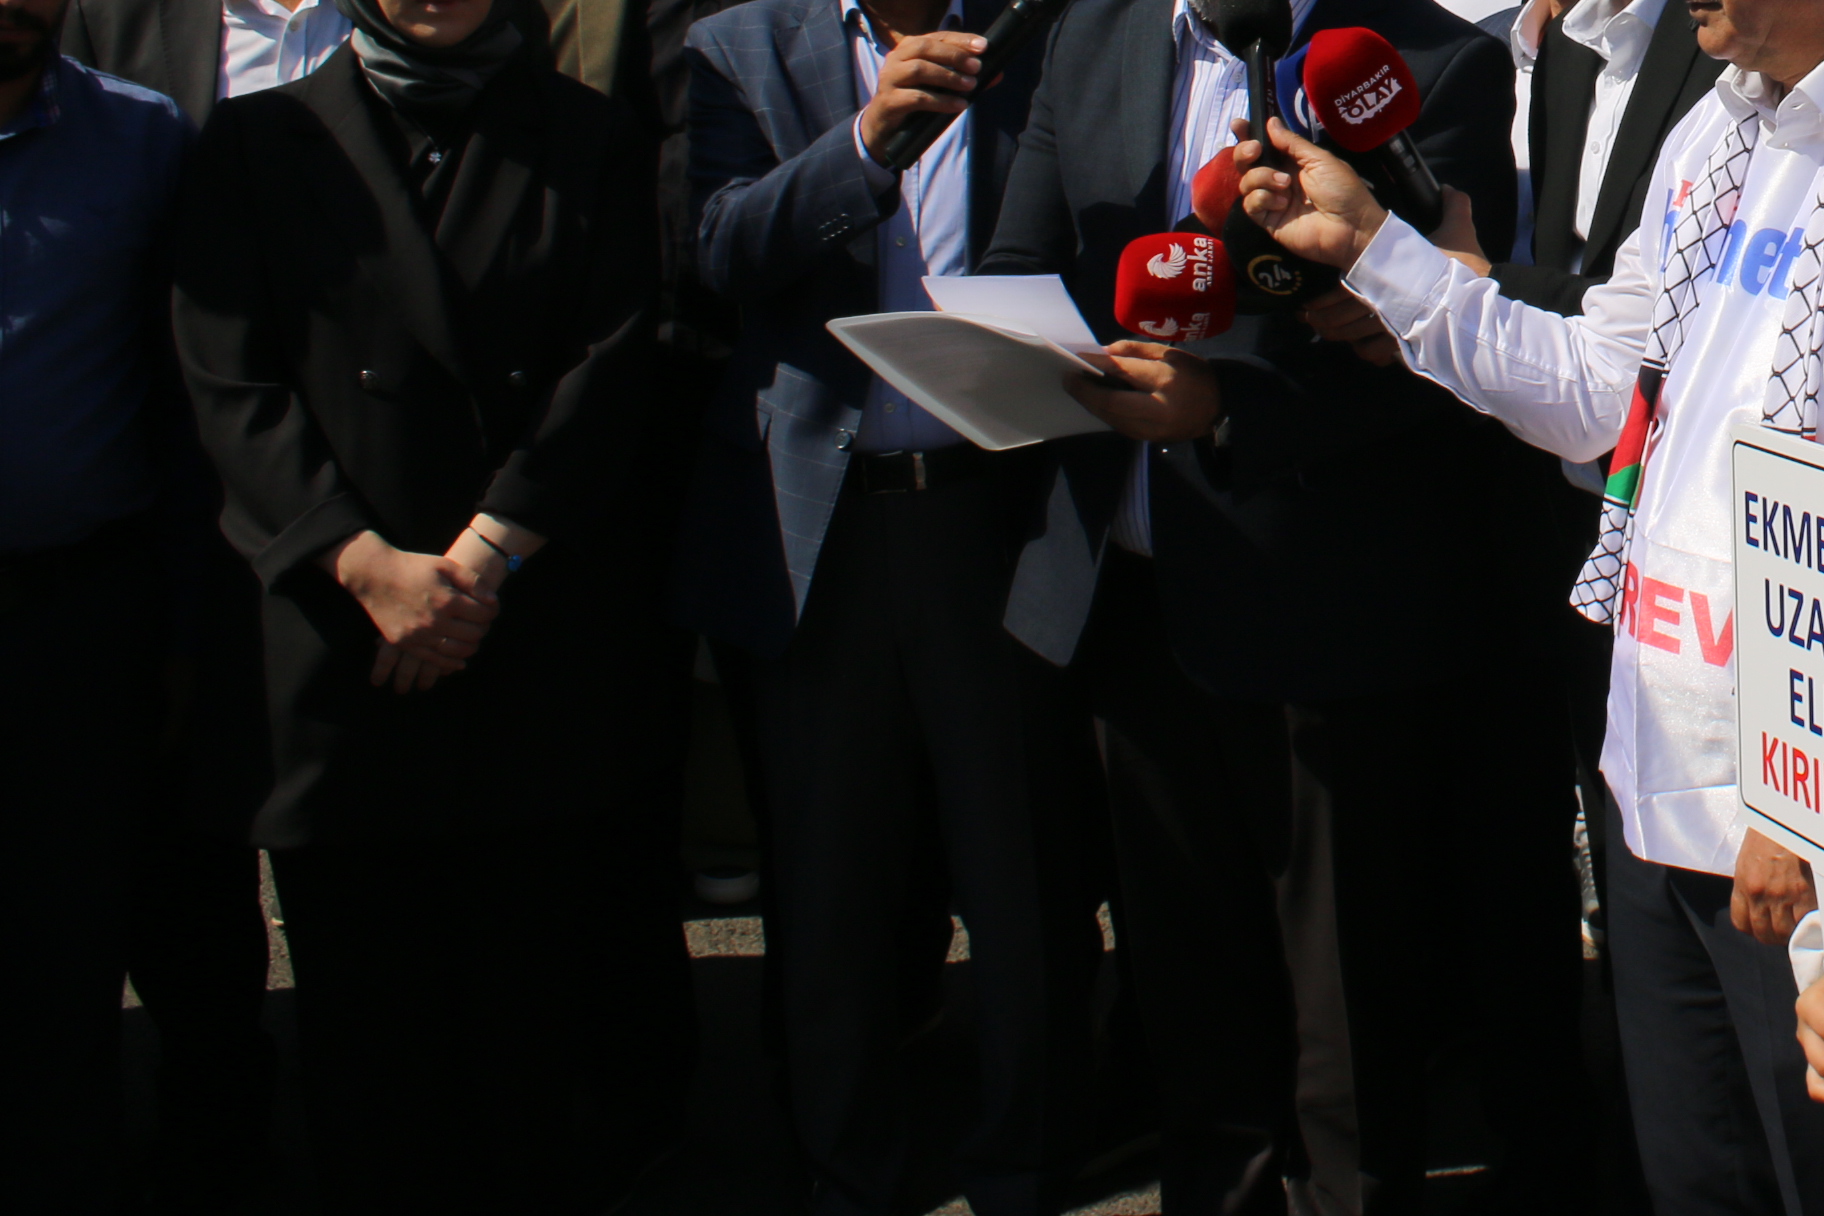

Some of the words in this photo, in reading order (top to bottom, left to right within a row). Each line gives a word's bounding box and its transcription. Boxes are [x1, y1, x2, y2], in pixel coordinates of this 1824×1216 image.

[1334, 65, 1390, 106] DİYARBAKIR
[1342, 78, 1398, 122] OLAY
[1187, 237, 1208, 292] anka
